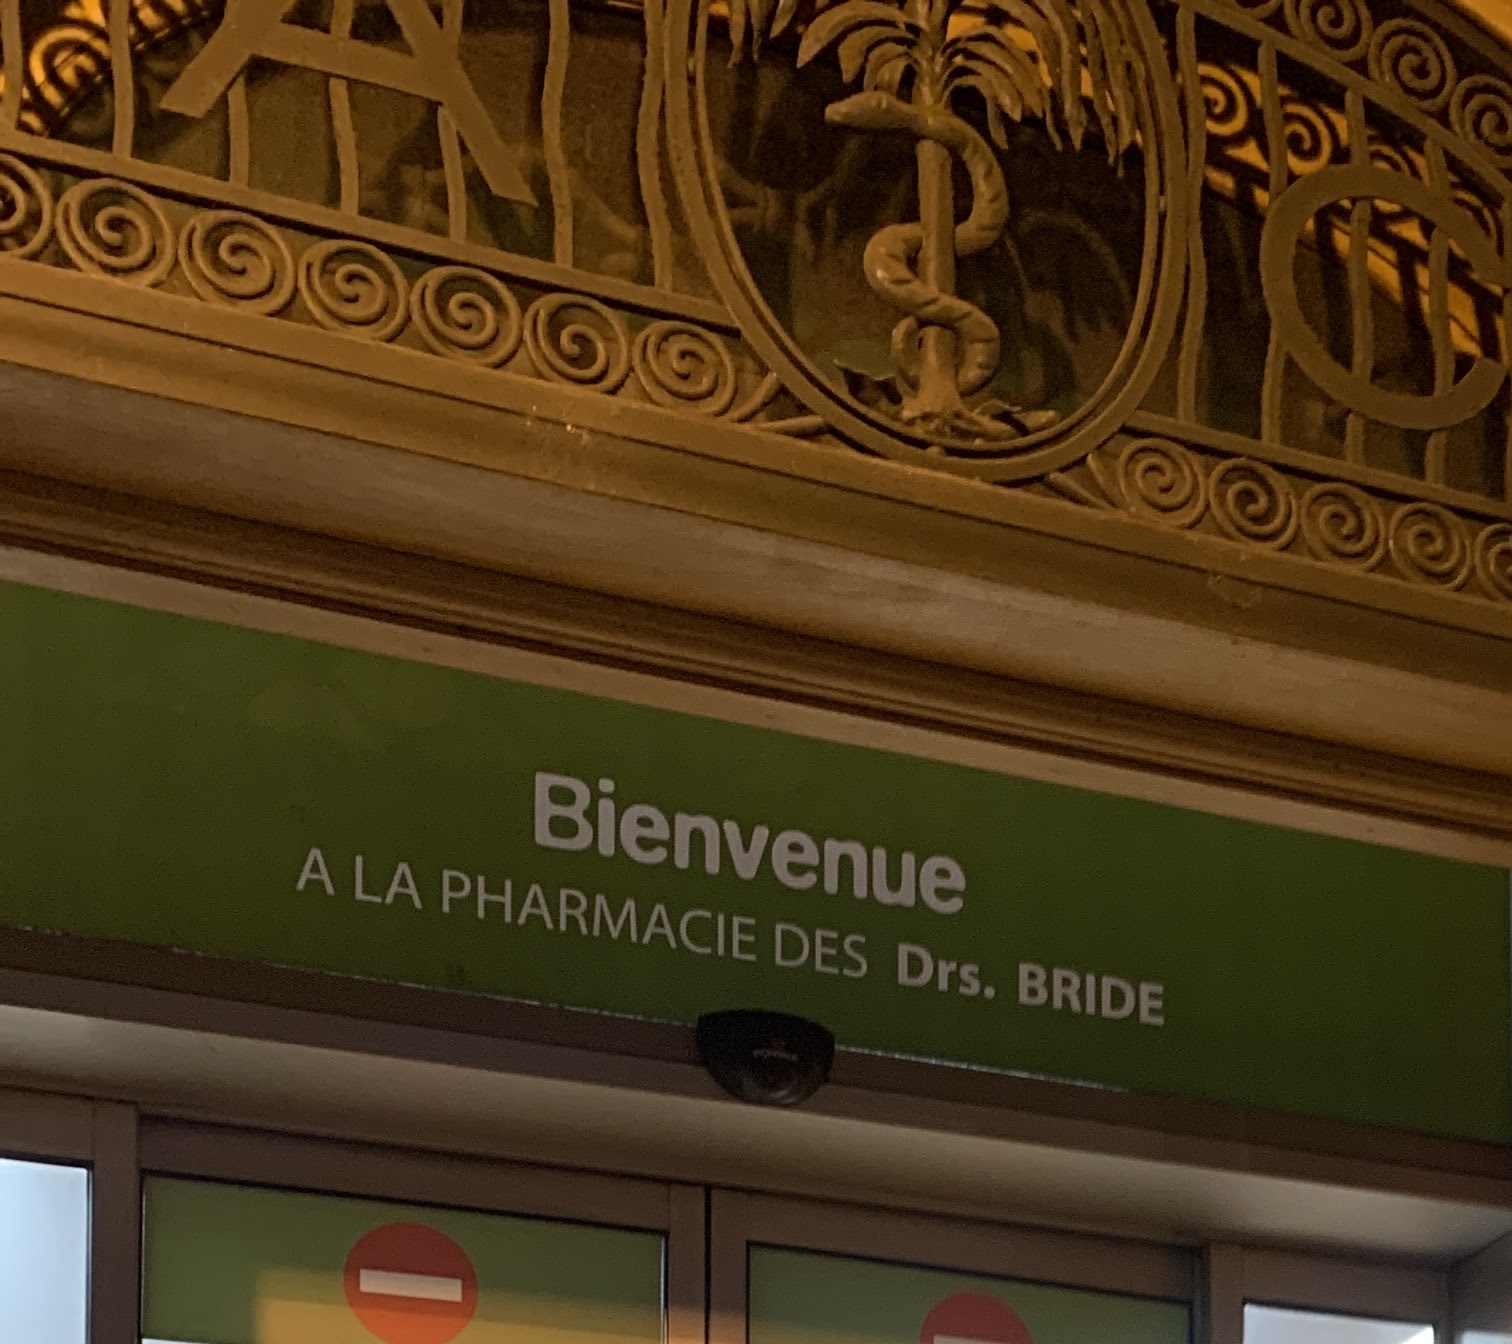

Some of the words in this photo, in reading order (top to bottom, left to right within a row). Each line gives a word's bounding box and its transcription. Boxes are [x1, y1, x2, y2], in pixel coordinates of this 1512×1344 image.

[1261, 164, 1508, 430] C
[533, 773, 966, 915] Bienvenue
[296, 848, 335, 893] A
[354, 857, 422, 911] LA
[441, 871, 758, 962] PHARMACIE
[775, 924, 868, 978] DES
[896, 943, 996, 999] Drs.
[1017, 964, 1166, 1026] BRIDE
